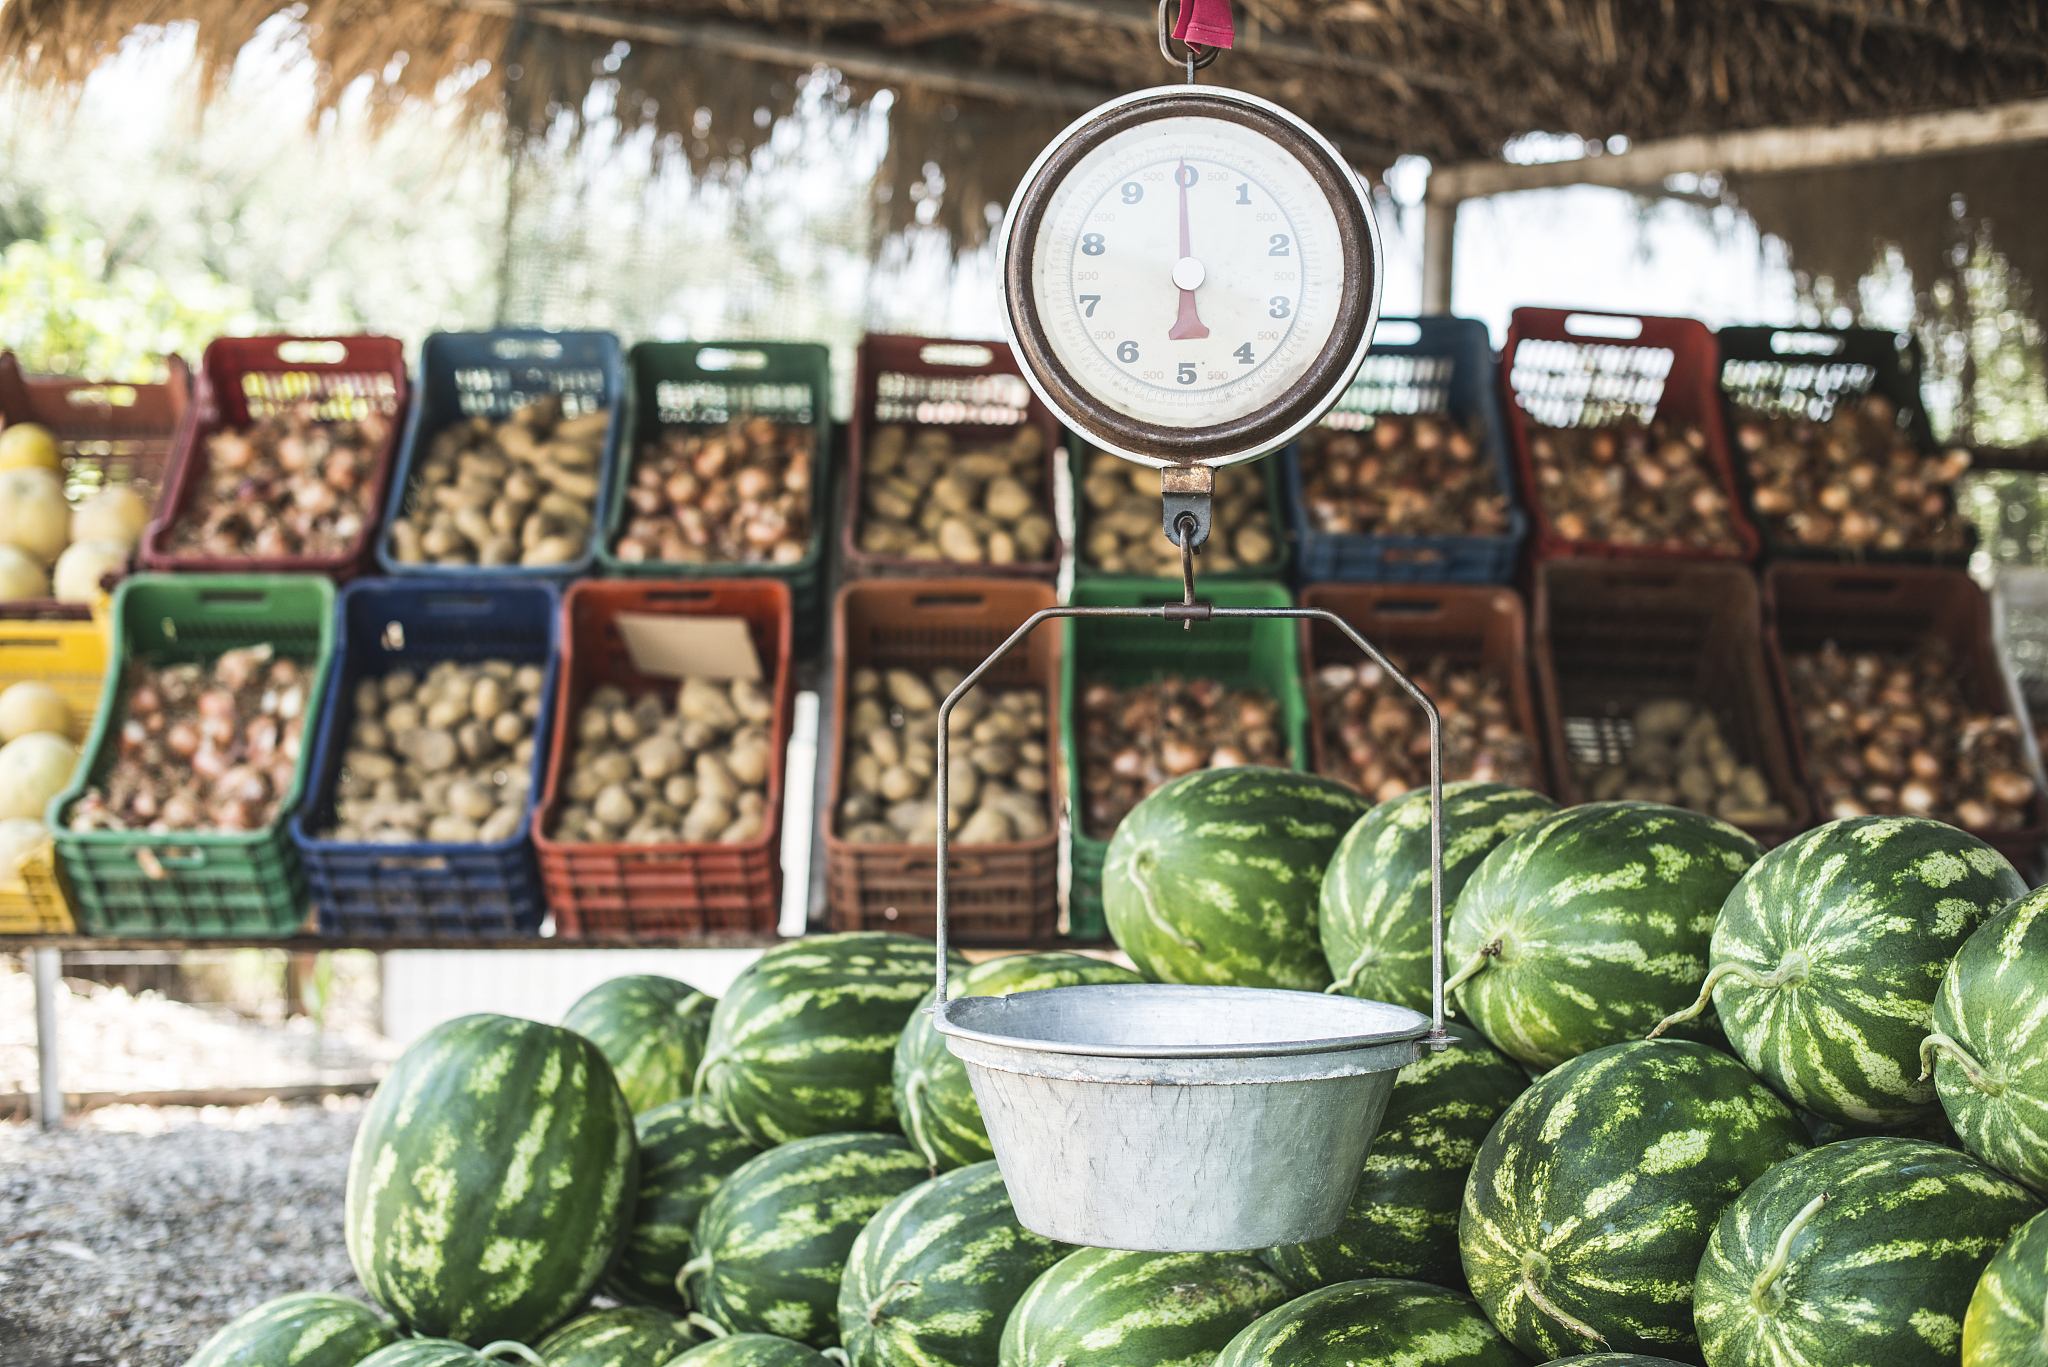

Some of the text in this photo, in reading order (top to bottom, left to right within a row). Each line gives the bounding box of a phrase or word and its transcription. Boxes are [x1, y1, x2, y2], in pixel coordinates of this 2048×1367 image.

[1143, 172, 1164, 181] 500
[1174, 165, 1199, 188] 0
[1207, 172, 1228, 181] 500
[1121, 181, 1144, 205] 9
[1236, 183, 1252, 205] 1
[1094, 212, 1115, 222] 500
[1256, 212, 1277, 222] 500
[1082, 232, 1106, 256] 8
[1268, 233, 1290, 256] 2
[1077, 271, 1099, 281] 500
[1274, 271, 1295, 281] 500
[1079, 295, 1101, 318] 7
[1269, 295, 1291, 319] 3
[1094, 331, 1115, 340] 500
[1257, 331, 1279, 340] 500
[1116, 340, 1139, 363] 6
[1233, 342, 1255, 364] 4
[1142, 370, 1164, 380] 500
[1176, 362, 1197, 385] 5
[1207, 370, 1228, 380] 500
